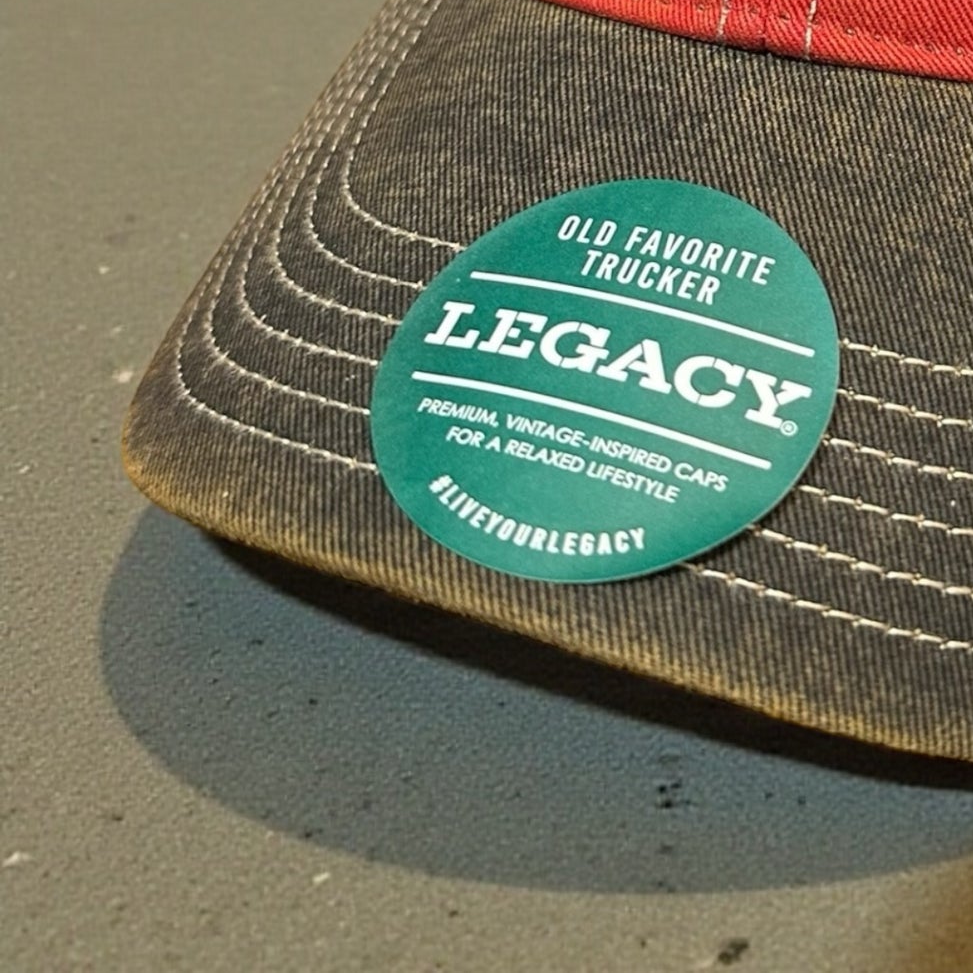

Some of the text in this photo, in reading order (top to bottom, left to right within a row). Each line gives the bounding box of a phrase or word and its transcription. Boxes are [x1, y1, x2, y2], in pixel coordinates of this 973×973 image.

[557, 214, 776, 286] OLD FAVORITE
[580, 249, 721, 306] TRUCKER
[445, 426, 681, 504] FOR A RELAXED LIFESTYLE
[504, 413, 673, 476] VINTAGE-INSPIRED
[673, 462, 730, 493] CAPS
[427, 474, 646, 556] #LIVEYOURLEGACY
